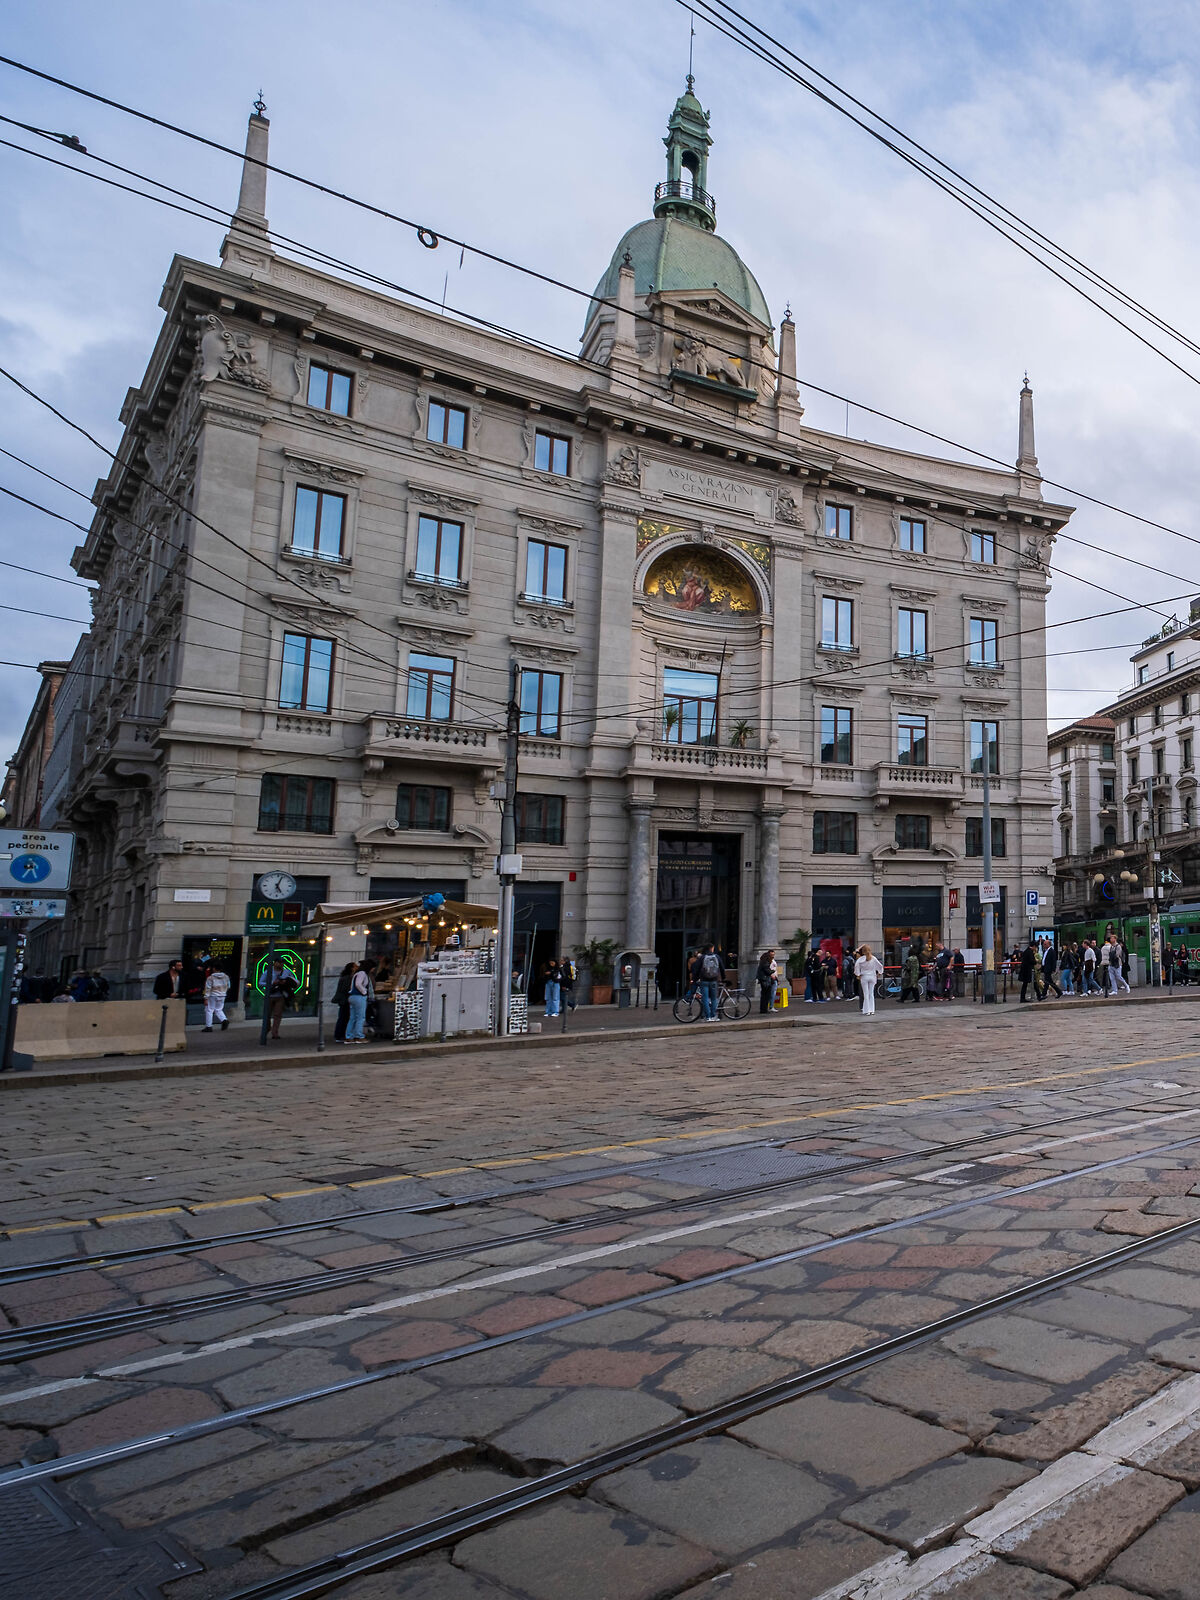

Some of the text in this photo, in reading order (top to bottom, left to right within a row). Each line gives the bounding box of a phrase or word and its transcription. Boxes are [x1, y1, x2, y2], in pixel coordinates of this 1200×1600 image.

[682, 484, 737, 503] GENERALI
[8, 842, 60, 851] pedonale
[1029, 893, 1036, 904] P
[818, 906, 847, 915] BOSS
[897, 906, 924, 915] BOSS
